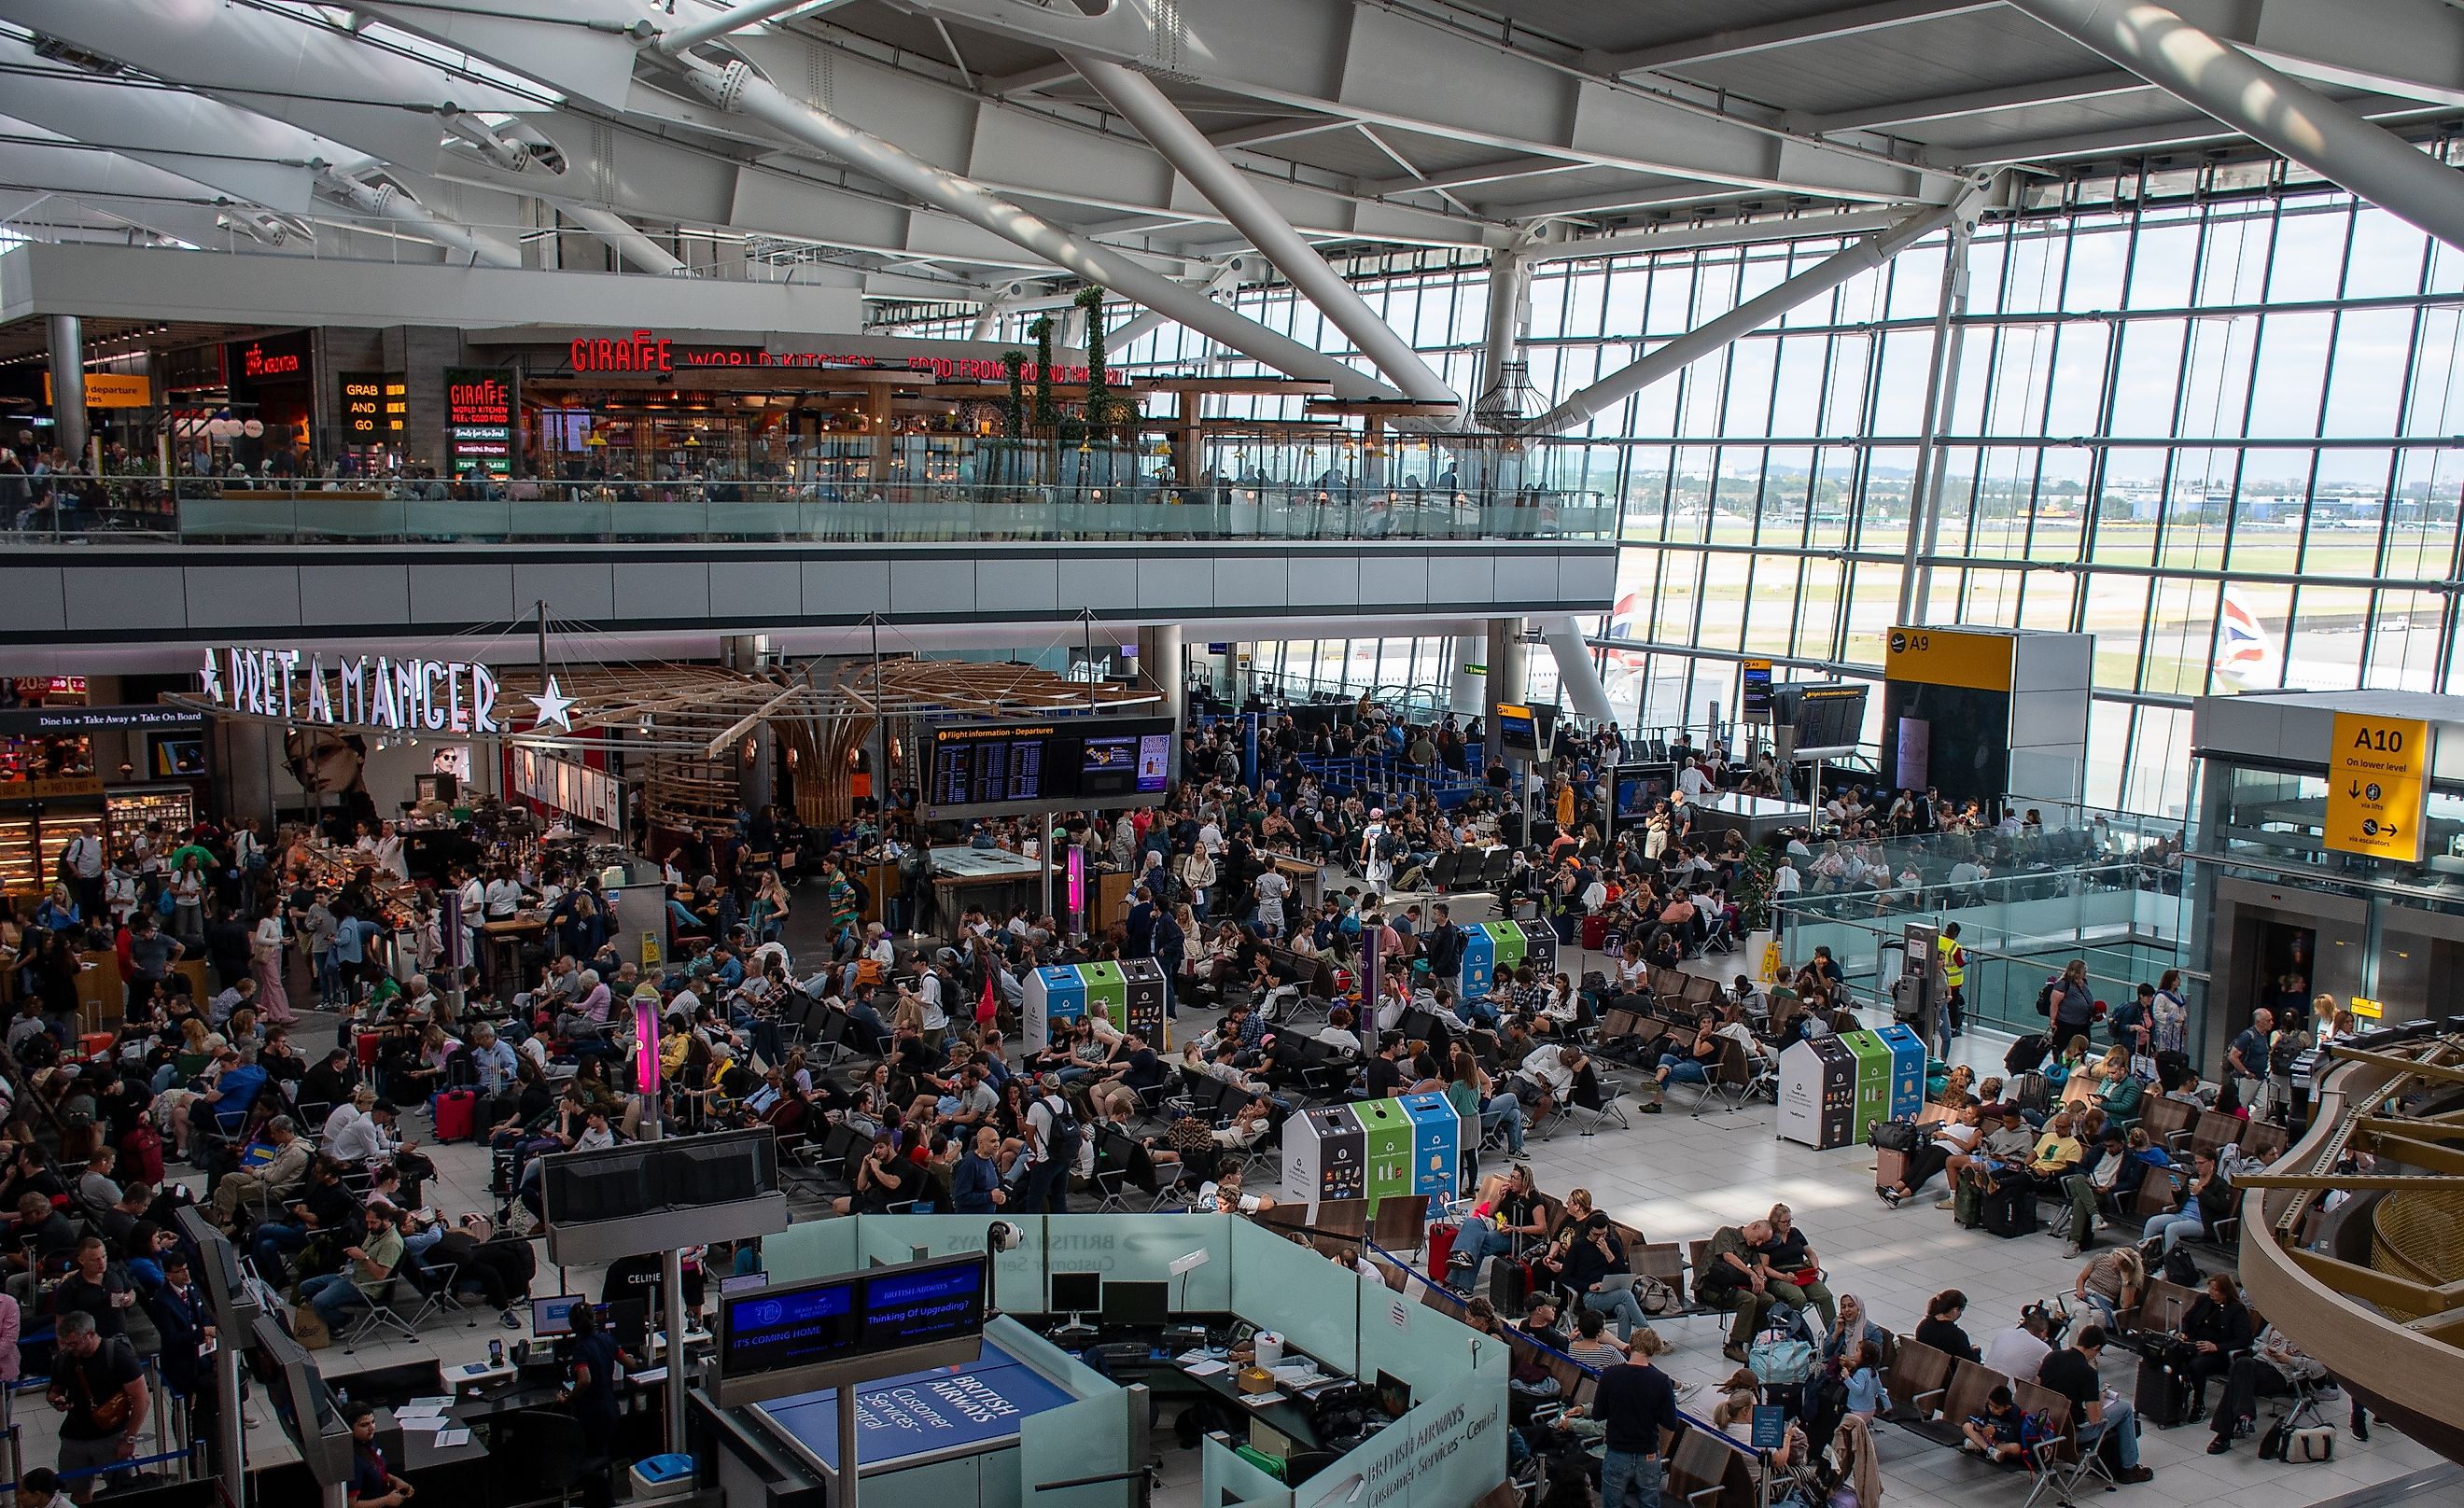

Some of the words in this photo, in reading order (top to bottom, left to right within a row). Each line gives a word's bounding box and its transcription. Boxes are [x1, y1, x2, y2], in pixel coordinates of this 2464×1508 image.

[571, 329, 673, 371] GIRAFFE
[959, 358, 1005, 381] FROM
[91, 385, 138, 397] departure
[346, 384, 379, 396] GRAB
[451, 380, 509, 406] GIRAFFE
[351, 402, 377, 413] AND
[355, 420, 374, 430] GO
[1910, 635, 1929, 651] A9
[231, 645, 298, 719] PRET
[307, 651, 334, 724] A
[340, 655, 501, 733] MANGER
[40, 717, 62, 727] Dine
[62, 717, 73, 725] In
[83, 715, 105, 725] Take
[105, 714, 129, 725] Away
[140, 713, 161, 722] Take
[161, 712, 175, 722] On
[176, 711, 202, 721] Board
[947, 730, 968, 740] Flight
[1015, 727, 1054, 736] Departures
[2354, 727, 2402, 753] A10
[2346, 758, 2359, 766] On
[2360, 760, 2385, 770] lower
[2386, 762, 2407, 773] level
[2371, 803, 2384, 811] lifts
[2359, 837, 2390, 847] escalators
[627, 1272, 662, 1285] CELINE
[884, 1287, 916, 1300] BRITISH
[915, 1282, 948, 1295] AIRWAYS
[867, 1311, 905, 1325] Thinking
[907, 1307, 918, 1318] Of
[920, 1299, 970, 1316] Upgrading?
[734, 1338, 749, 1348] IT'S
[751, 1330, 791, 1345] COMING
[792, 1325, 821, 1339] HOME
[925, 1379, 998, 1423] AIRWAYS
[952, 1375, 1019, 1417] BRITISH
[891, 1388, 954, 1429] Customer
[1367, 1437, 1415, 1485] BRITISH
[1416, 1403, 1464, 1451] AIRWAYS
[1367, 1465, 1416, 1508] Customer
[1418, 1437, 1459, 1476] Services
[1466, 1403, 1498, 1440] Central
